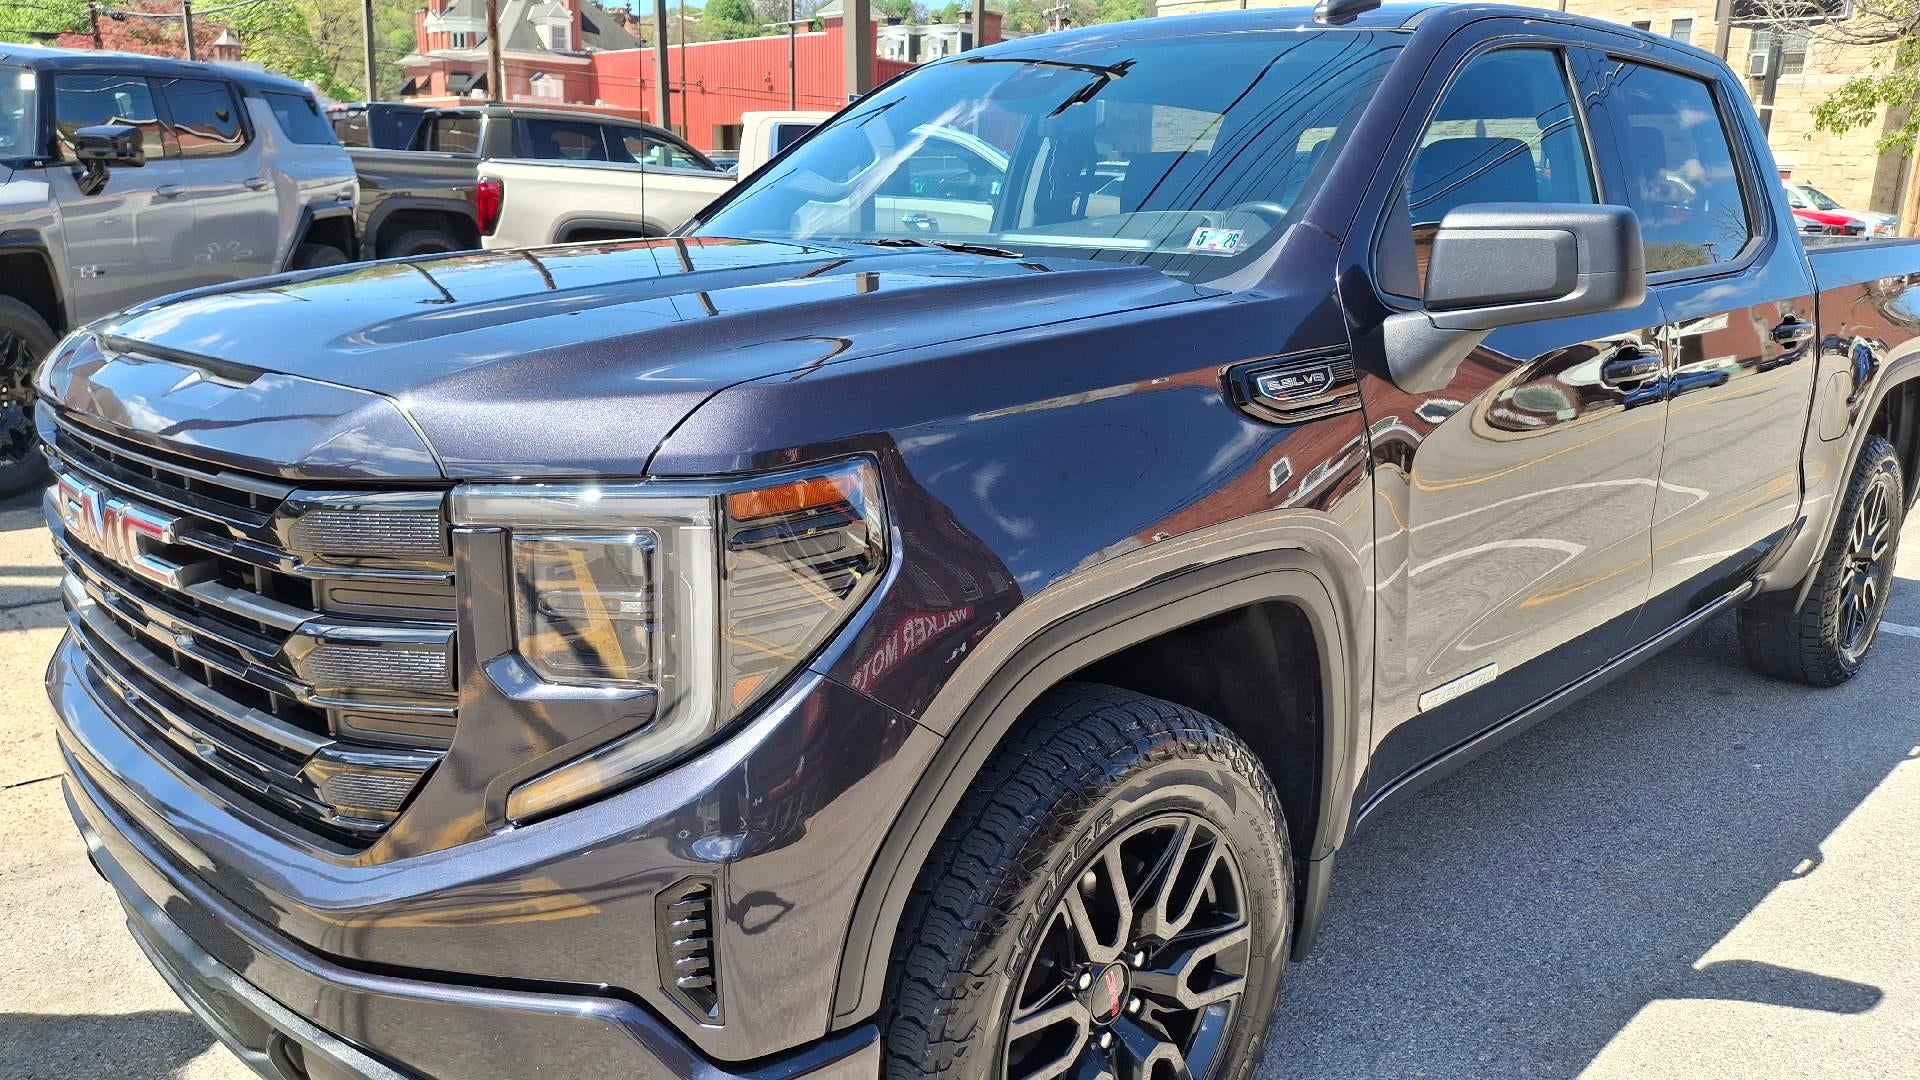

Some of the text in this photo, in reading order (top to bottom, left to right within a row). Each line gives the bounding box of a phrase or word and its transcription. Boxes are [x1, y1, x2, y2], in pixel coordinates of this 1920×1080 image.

[1195, 230, 1208, 246] 5
[58, 473, 182, 591] GMC
[1427, 670, 1495, 705] ELEVATION
[1004, 807, 1114, 980] COOPER
